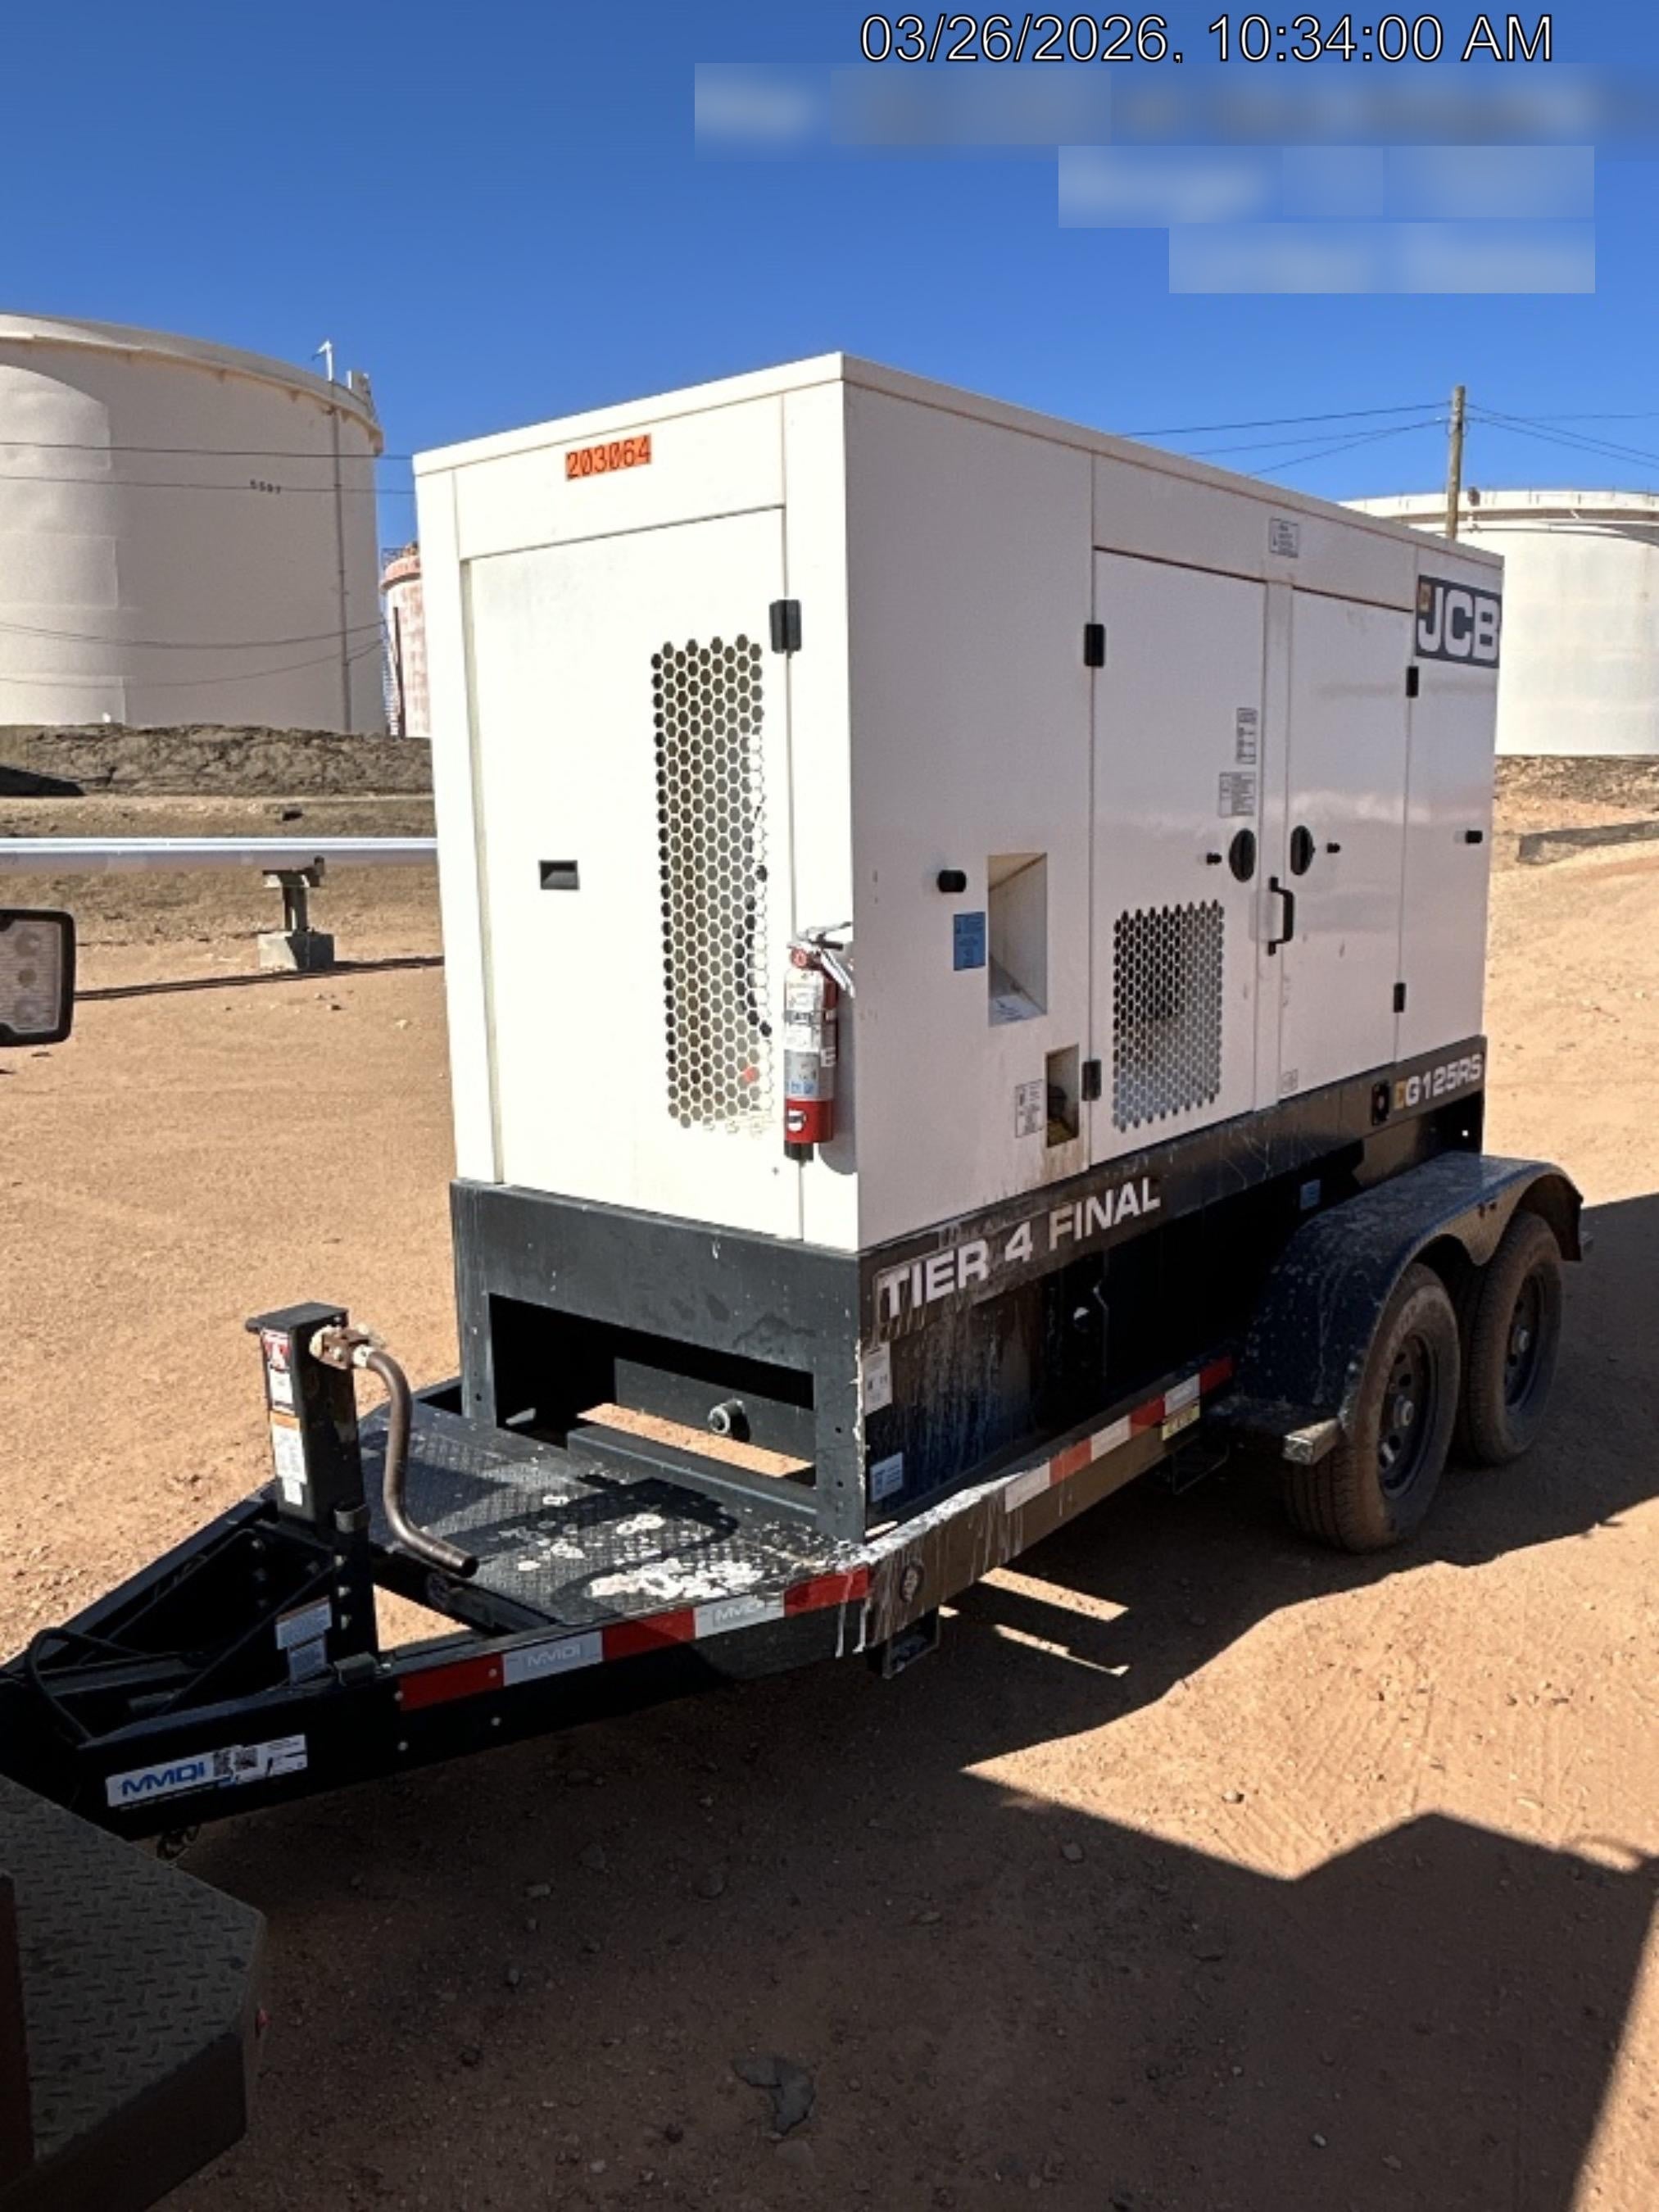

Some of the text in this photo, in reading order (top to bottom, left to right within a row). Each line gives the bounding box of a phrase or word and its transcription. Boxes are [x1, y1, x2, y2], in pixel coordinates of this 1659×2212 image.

[565, 433, 651, 482] 203064
[1417, 586, 1500, 661] JCB
[882, 1176, 1162, 1319] TIER 4 FINAL
